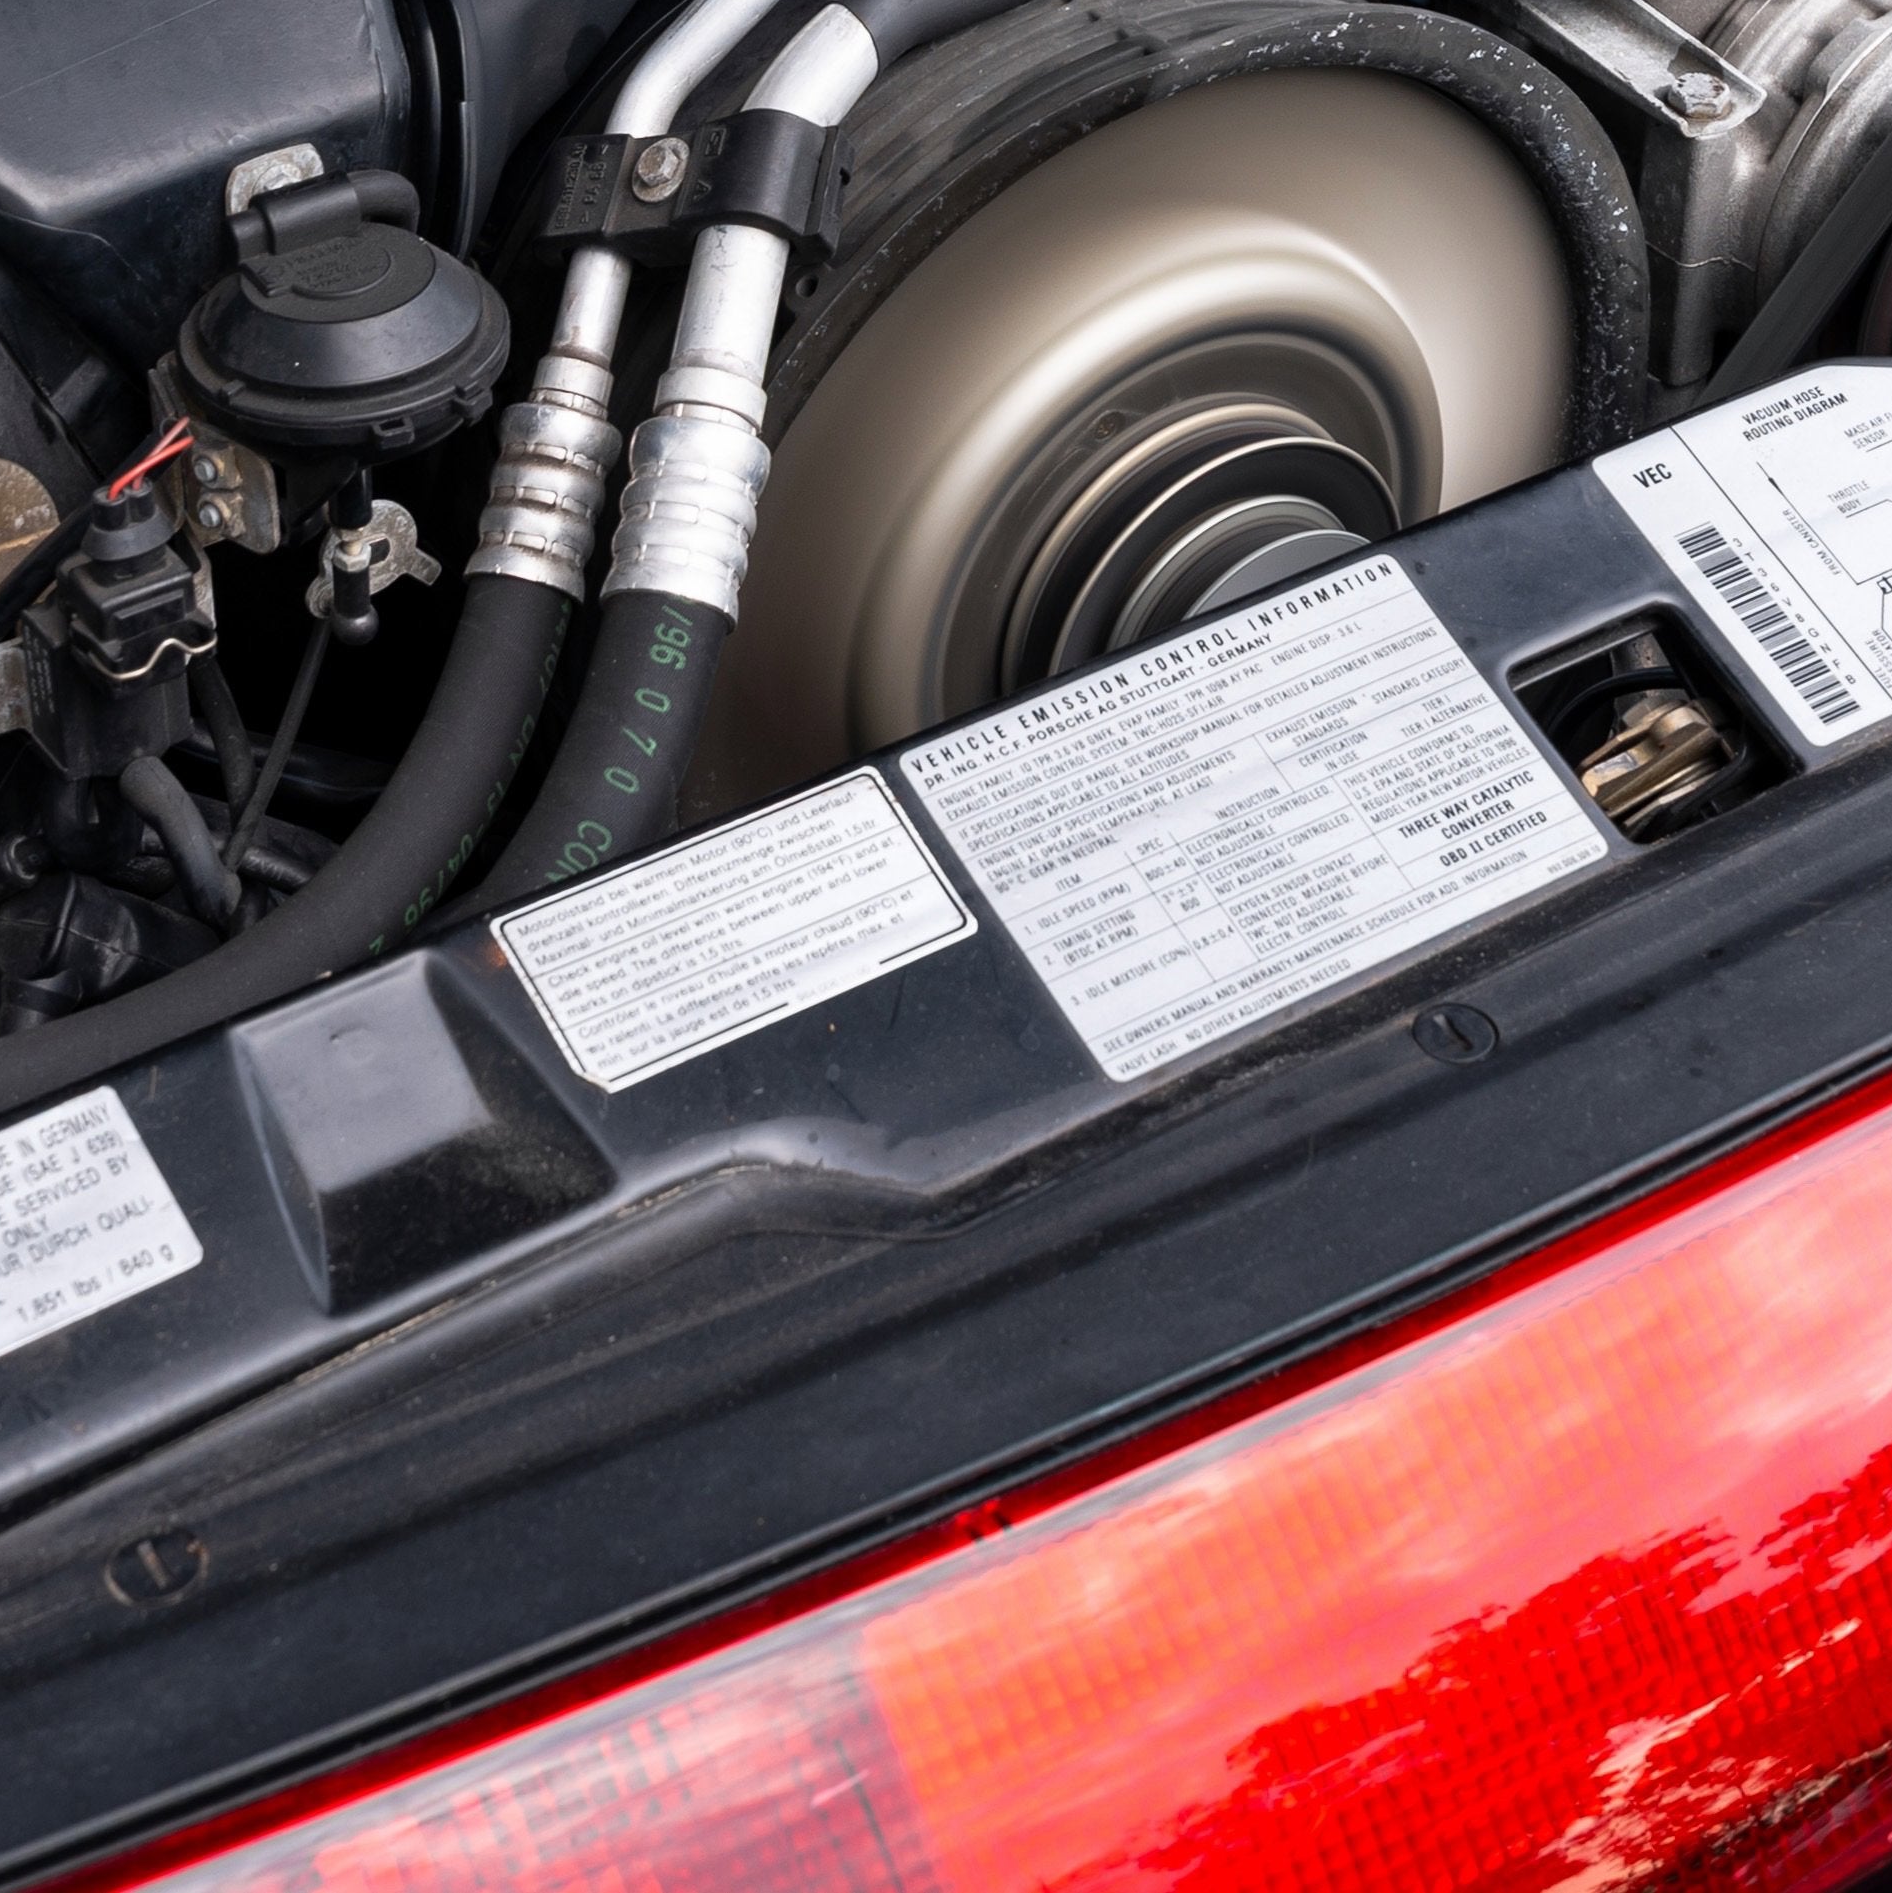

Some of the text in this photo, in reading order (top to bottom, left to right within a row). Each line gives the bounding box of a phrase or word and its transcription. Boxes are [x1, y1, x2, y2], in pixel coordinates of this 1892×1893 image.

[1741, 385, 1825, 425] VACUUM HOSE
[1741, 391, 1849, 442] ROUTING DIAGRAM
[1842, 422, 1871, 439] MASS
[1867, 415, 1886, 429] AIR
[1851, 428, 1889, 449] SENSOR
[1631, 461, 1675, 489] VEC
[1826, 479, 1871, 504] THROTTLE
[1836, 497, 1863, 514] BODY
[1781, 507, 1842, 576] FROM CANISTER
[909, 561, 1394, 774] VEHICLE EMISSION CONTROL INFORMATION
[922, 770, 951, 789] DR.
[949, 757, 982, 777] ING.
[982, 738, 1027, 763] H.C.F.
[1025, 708, 1096, 744] PORSCHE
[1094, 698, 1118, 715] AG
[1117, 665, 1197, 705] STUTTGART
[1205, 632, 1275, 668] GERMANY
[935, 784, 979, 809] ENGINE
[1030, 752, 1055, 768] TPR
[1116, 713, 1146, 732] EVAP
[1183, 687, 1206, 702] TPR
[1227, 670, 1244, 684] AY
[1241, 662, 1264, 678] PAC
[1269, 643, 1309, 666] ENGINE
[943, 794, 992, 821] EXHAUST
[989, 772, 1044, 802] EMISSION
[1040, 752, 1090, 780] CONTROL
[1342, 723, 1475, 788] THIS VEHICLE CONFORMS TO
[1369, 745, 1531, 825] MODEL YEAR NEW MOTOR VEHICLES
[1397, 769, 1536, 839] THREE WAY CATALYTIC
[1439, 798, 1516, 840] CONVERTER
[1053, 784, 1281, 891] ITEM SPEC INSTRUCTION
[1437, 809, 1549, 867] OBD II CERTIFIED
[1101, 1036, 1125, 1053] SEE
[1123, 1014, 1172, 1043] OWNERS
[1169, 994, 1215, 1022] MANUAL
[1212, 983, 1239, 1001] AND
[1363, 900, 1417, 931] SCHEDULE
[1415, 890, 1439, 907] FOR
[1460, 848, 1529, 886] INFORMATION
[13, 1166, 102, 1217] SERVICED
[105, 1152, 134, 1176] BY
[0, 1214, 53, 1250] ONLY
